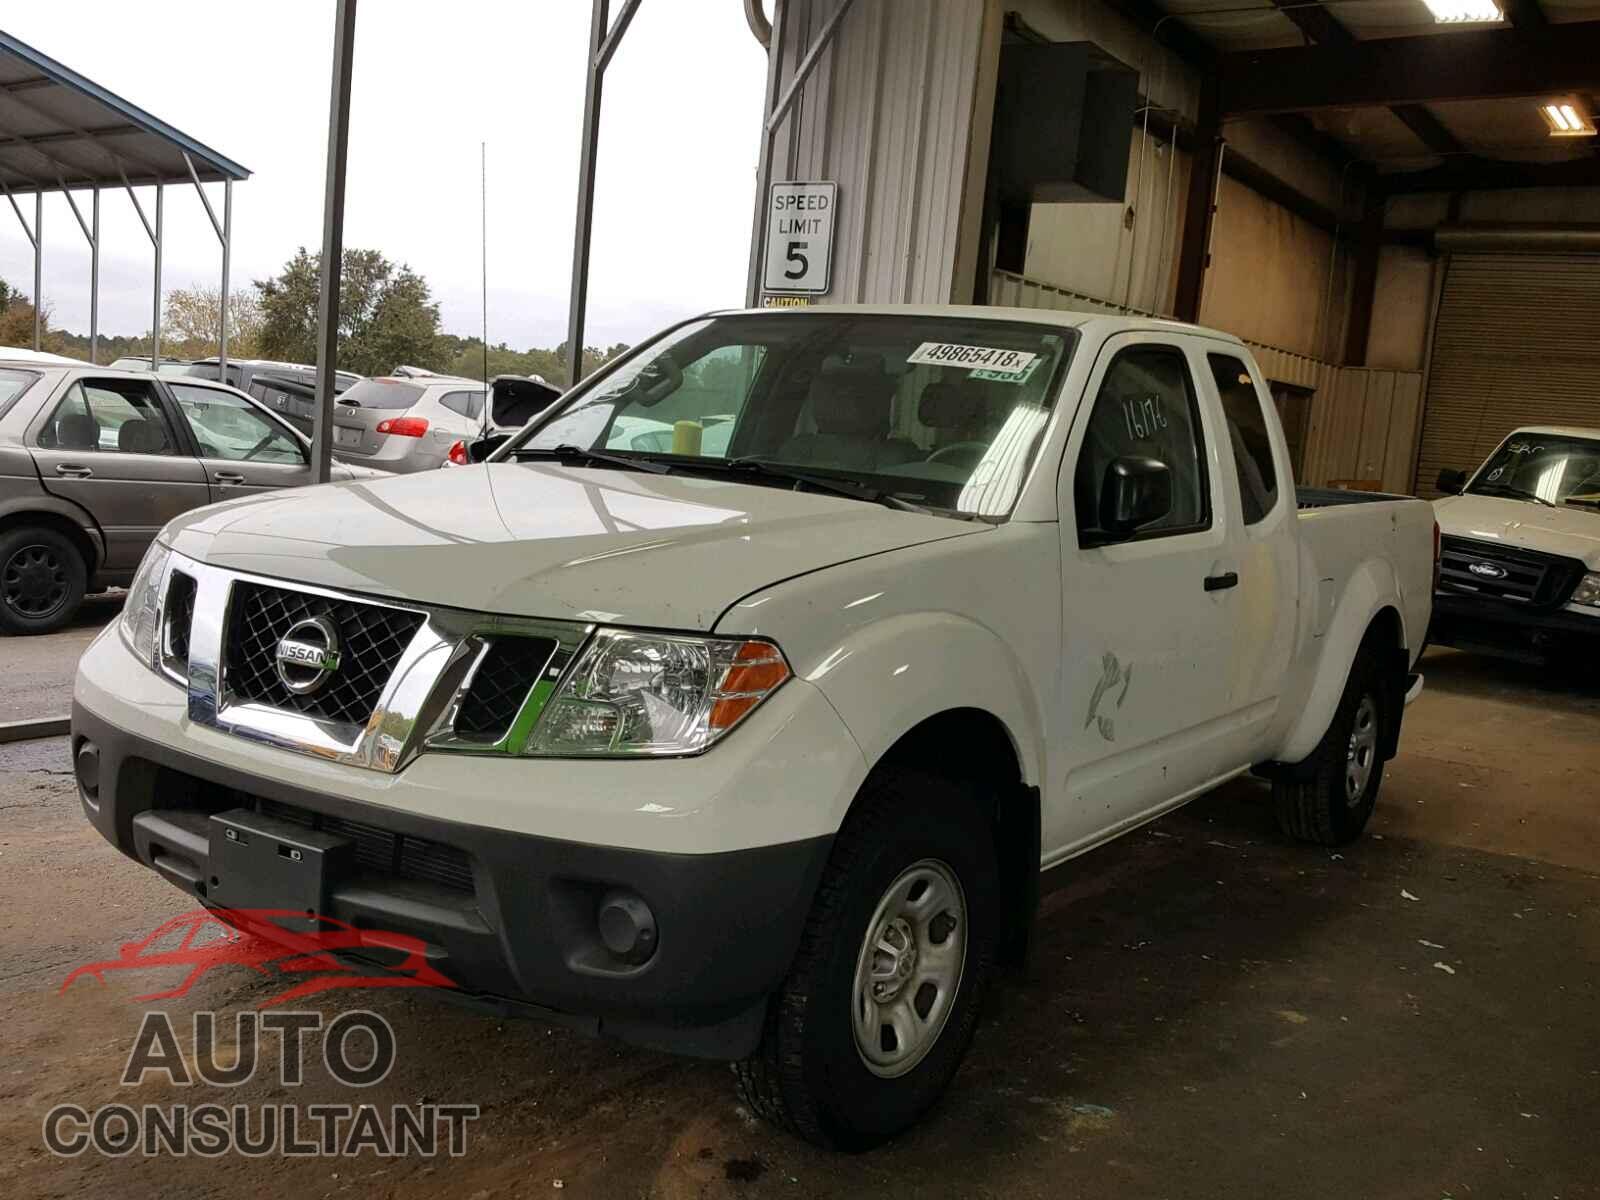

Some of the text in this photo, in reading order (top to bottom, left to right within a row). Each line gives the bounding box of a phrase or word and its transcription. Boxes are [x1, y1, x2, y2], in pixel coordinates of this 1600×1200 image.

[775, 195, 828, 210] SPEED
[779, 219, 821, 234] LIMIT
[784, 241, 808, 280] 5
[764, 297, 808, 307] CAUTION
[279, 643, 329, 666] NISSAN
